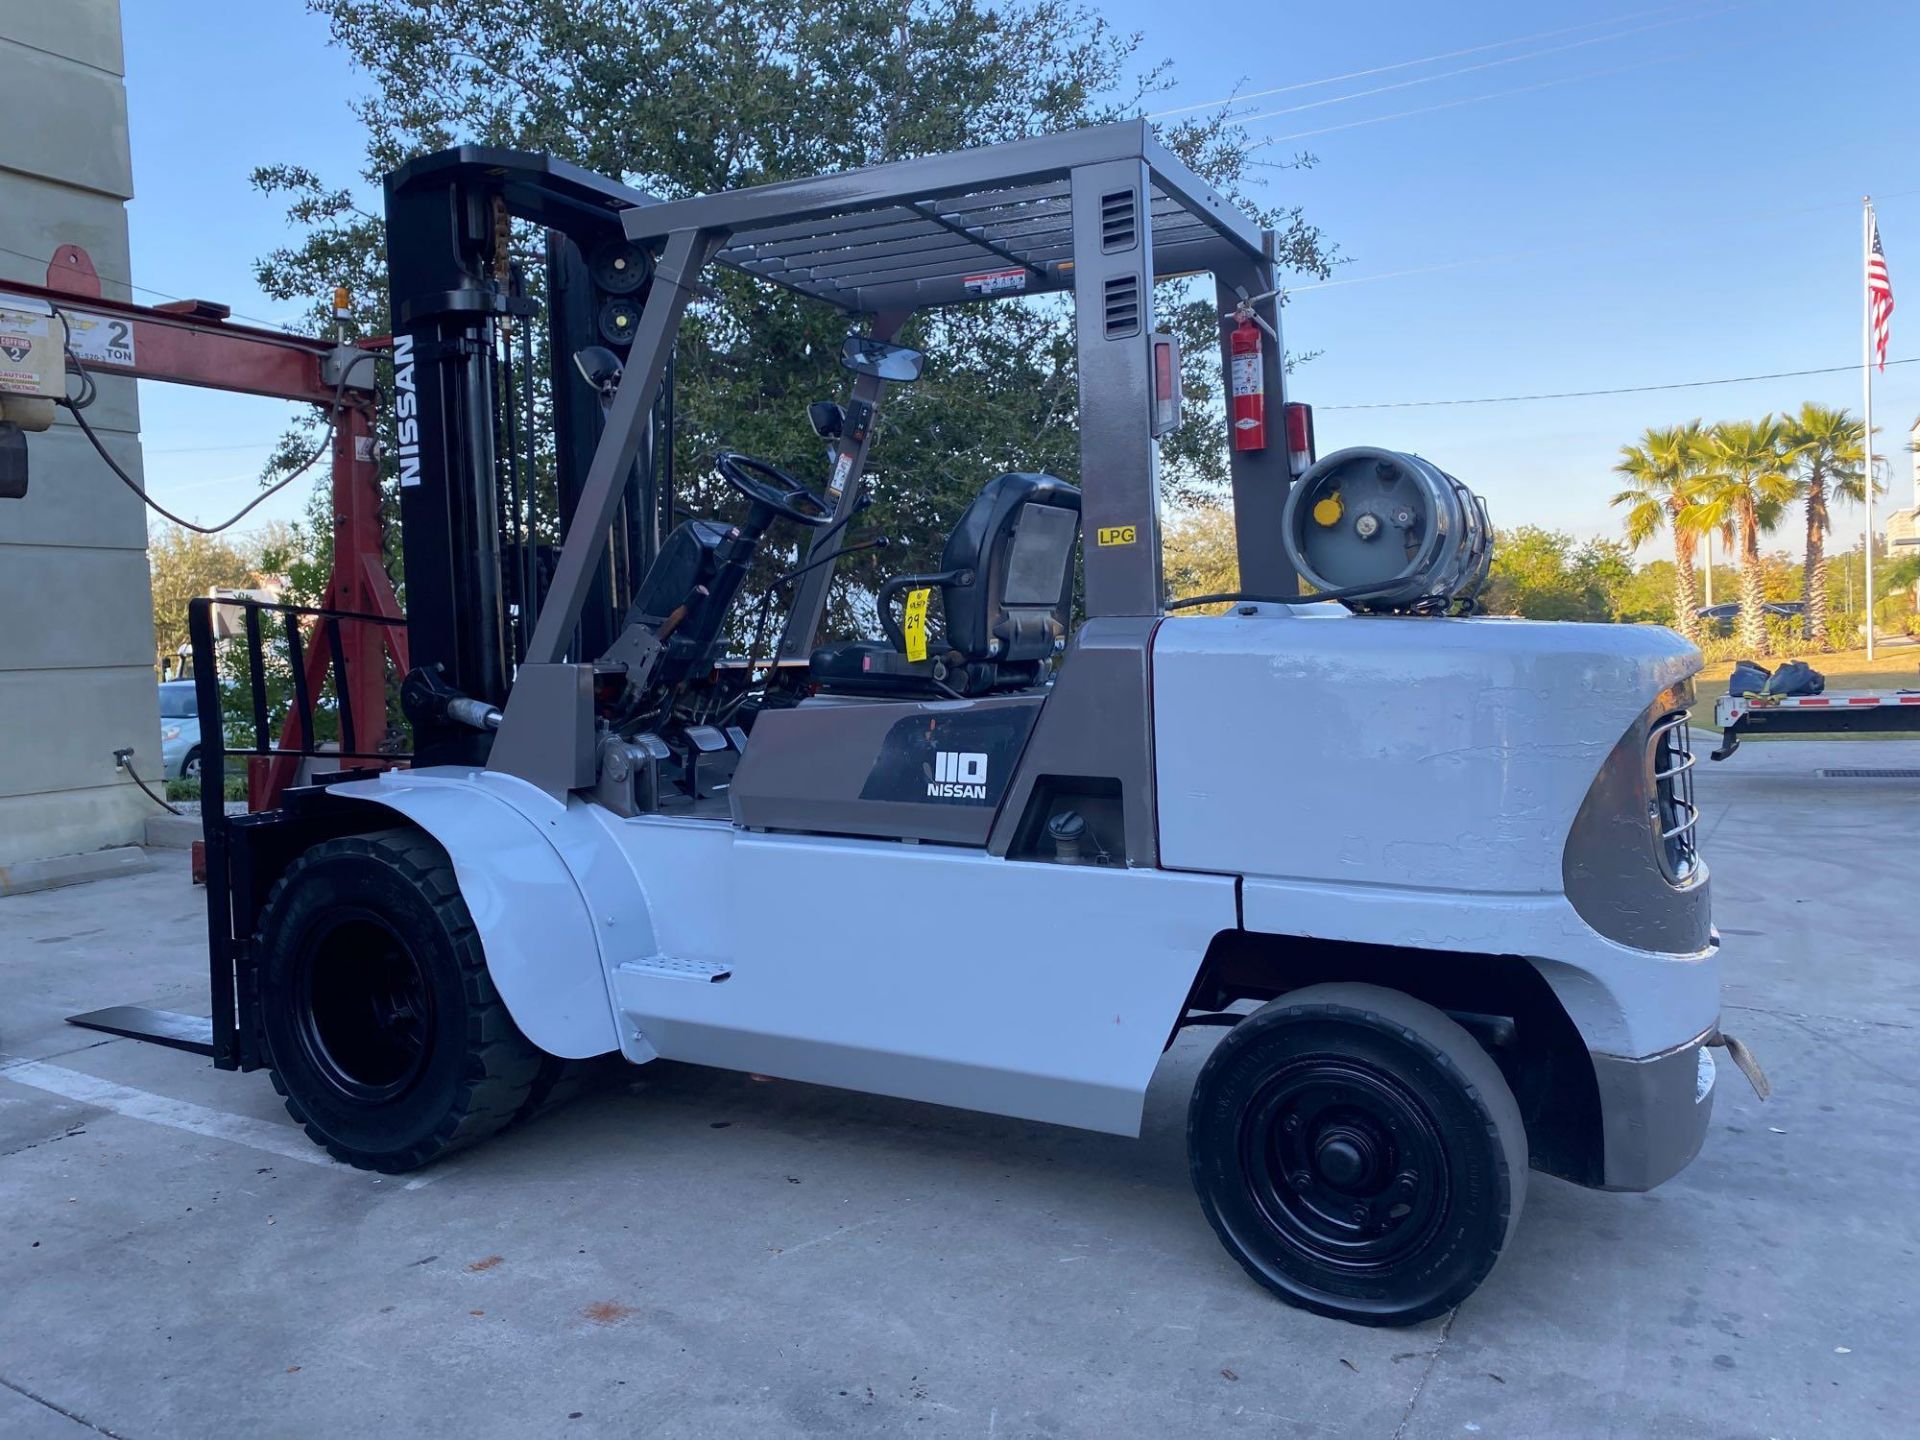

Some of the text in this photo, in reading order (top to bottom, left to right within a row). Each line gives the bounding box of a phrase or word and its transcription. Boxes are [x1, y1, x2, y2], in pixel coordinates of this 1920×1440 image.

[108, 321, 129, 349] 2
[11, 347, 20, 360] 2
[105, 348, 132, 361] TON
[393, 334, 421, 487] NISSAN
[1100, 528, 1134, 544] LPG
[907, 613, 920, 630] 29
[935, 751, 988, 784] 110
[927, 783, 987, 799] NISSAN
